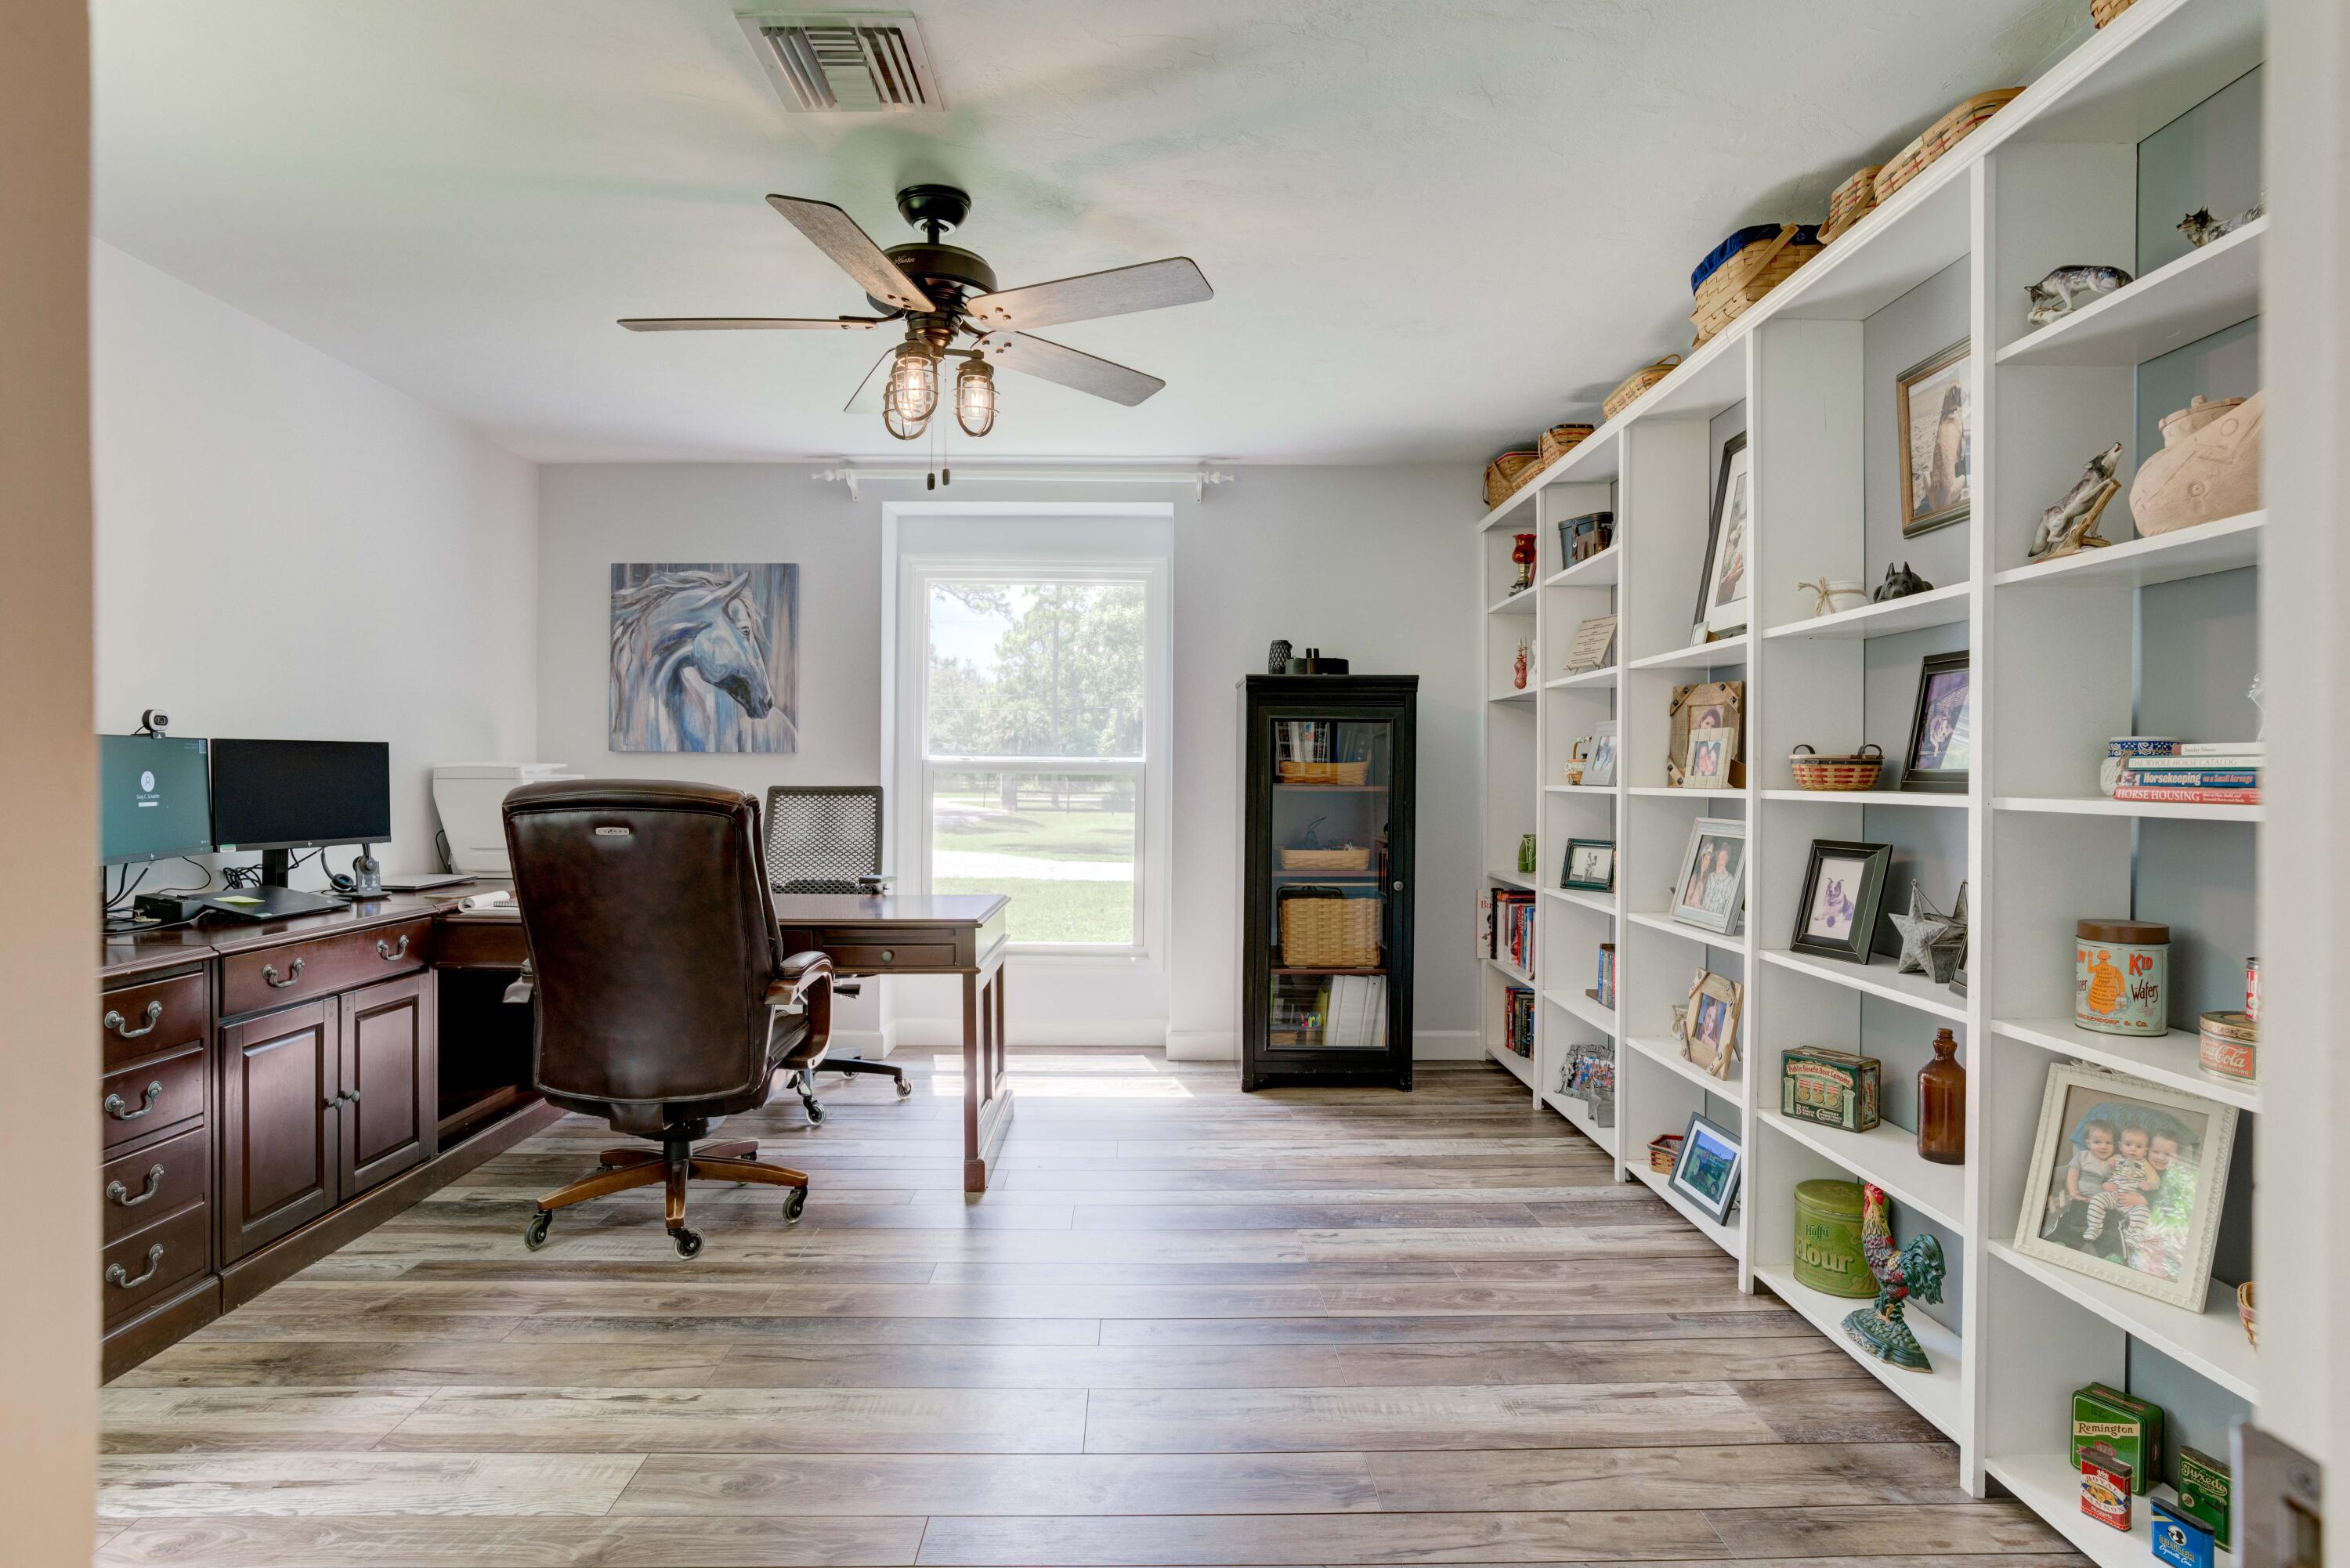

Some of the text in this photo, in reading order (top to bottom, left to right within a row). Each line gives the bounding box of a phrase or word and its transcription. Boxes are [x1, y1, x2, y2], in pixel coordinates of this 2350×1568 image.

[895, 255, 916, 265] Hunter
[2143, 772, 2201, 786] Horsekeeping
[2117, 789, 2200, 801] HORSE HOUSING
[2128, 952, 2153, 977] KID
[2131, 979, 2159, 1007] Wafers
[1819, 1067, 1830, 1076] Boot
[1806, 1224, 1832, 1241] Fluffy
[1795, 1238, 1855, 1274] Flour
[2078, 1422, 2134, 1436] Remington
[2086, 1475, 2118, 1494] ROYAL
[2181, 1461, 2228, 1494] Tuxedo
[2091, 1506, 2113, 1519] Nuggets
[2159, 1534, 2195, 1563] BUGLER
